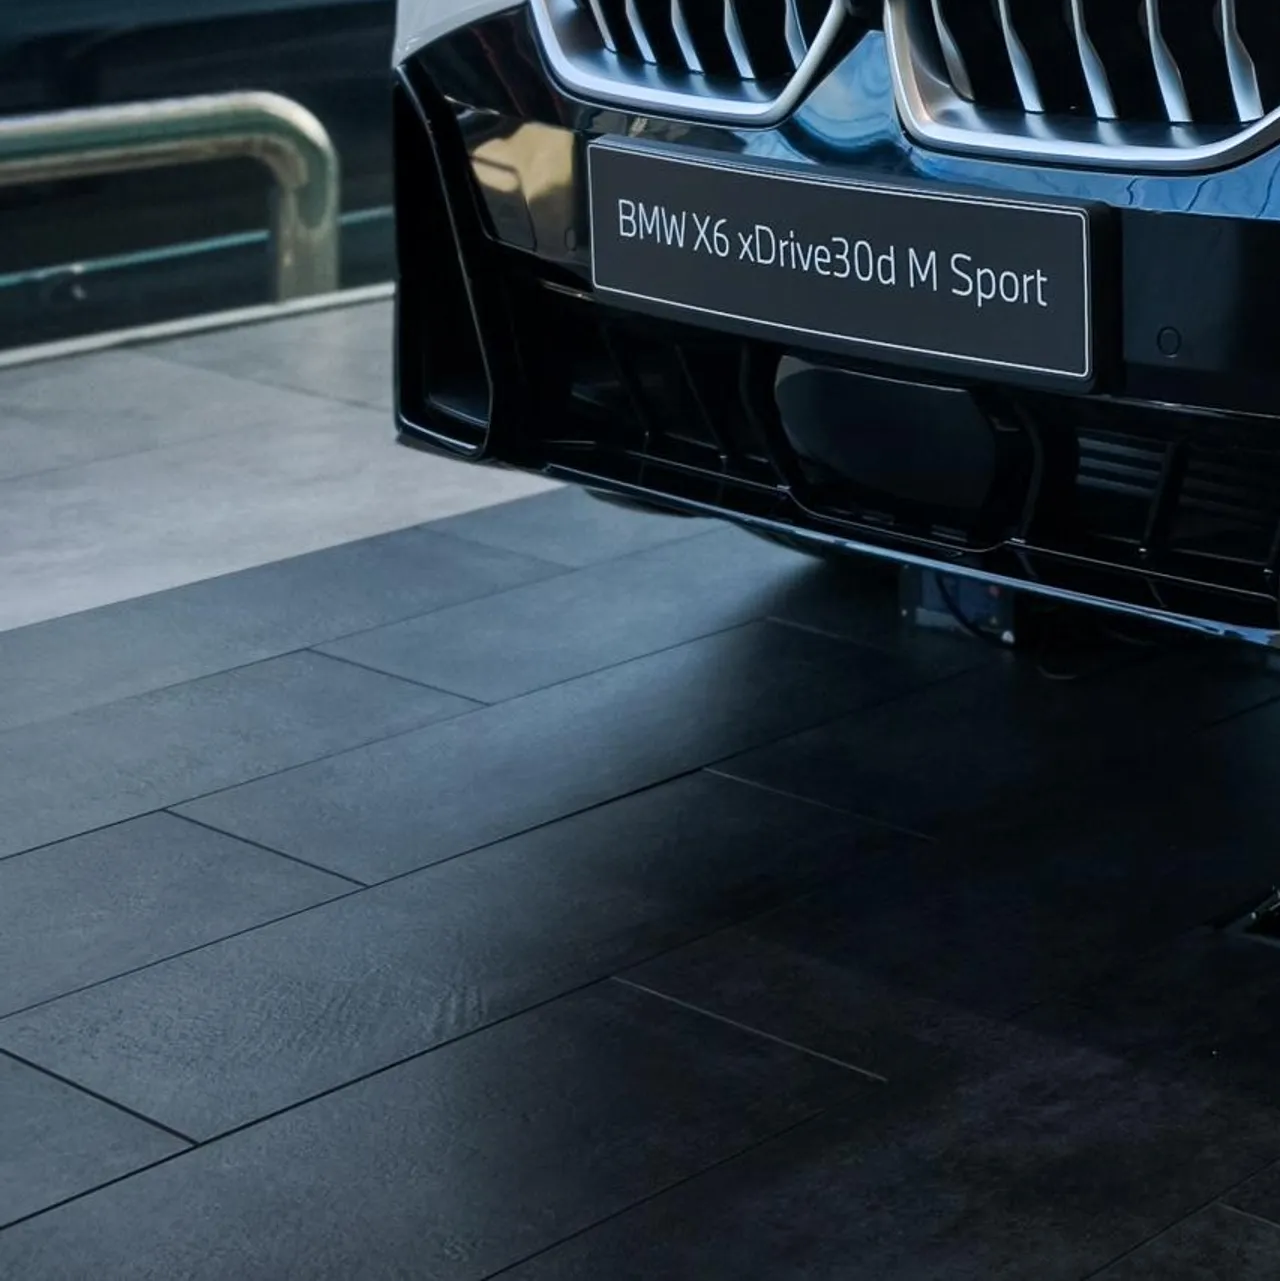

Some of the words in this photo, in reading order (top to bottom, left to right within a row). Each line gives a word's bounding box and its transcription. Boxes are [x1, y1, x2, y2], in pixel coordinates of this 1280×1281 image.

[617, 198, 687, 249] BMW
[692, 212, 730, 258] X6
[737, 223, 897, 286] xDrive30d
[908, 246, 938, 292] M
[950, 252, 1049, 308] Sport
